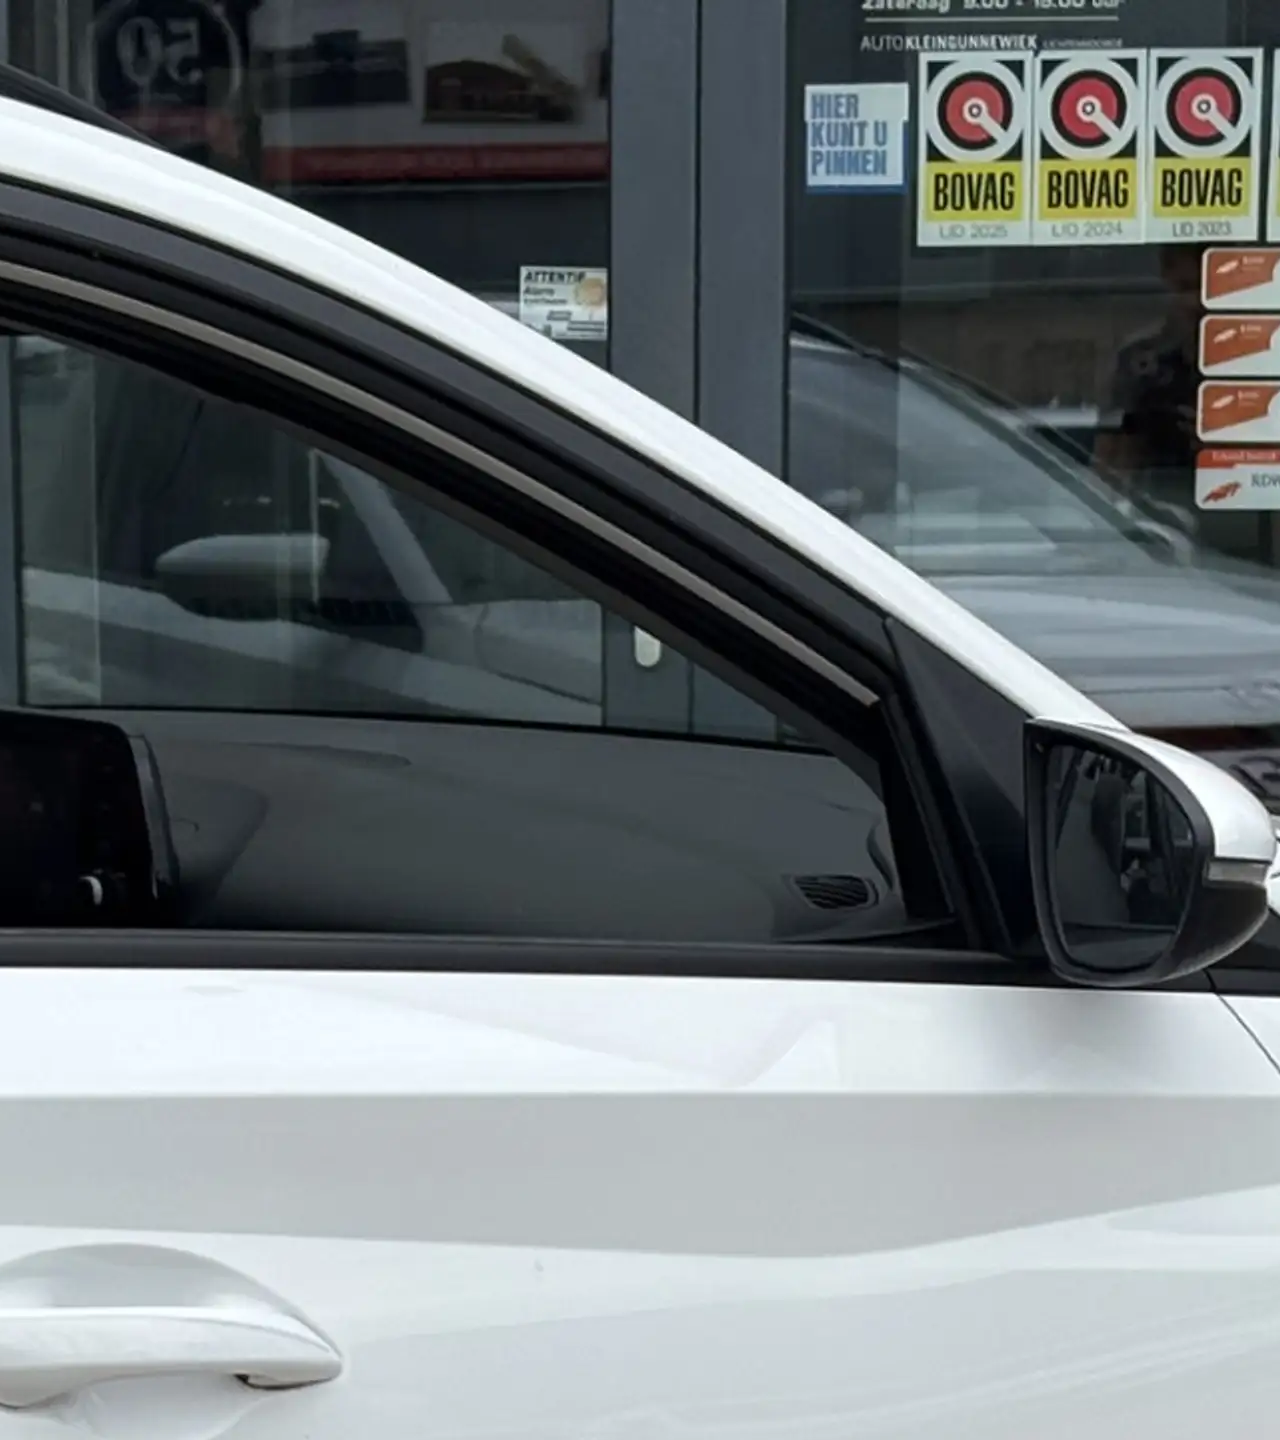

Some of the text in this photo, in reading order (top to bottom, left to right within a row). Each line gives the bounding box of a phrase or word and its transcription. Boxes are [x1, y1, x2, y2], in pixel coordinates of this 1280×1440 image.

[811, 93, 859, 120] HIER
[811, 120, 887, 148] KUNT U
[811, 149, 887, 176] PINNEN
[933, 172, 1015, 211] BOVAG
[1047, 169, 1129, 208] BOVAG
[1161, 168, 1243, 208] BOVAG
[939, 224, 965, 239] LID
[1051, 223, 1079, 238] LID
[1172, 222, 1193, 238] LID
